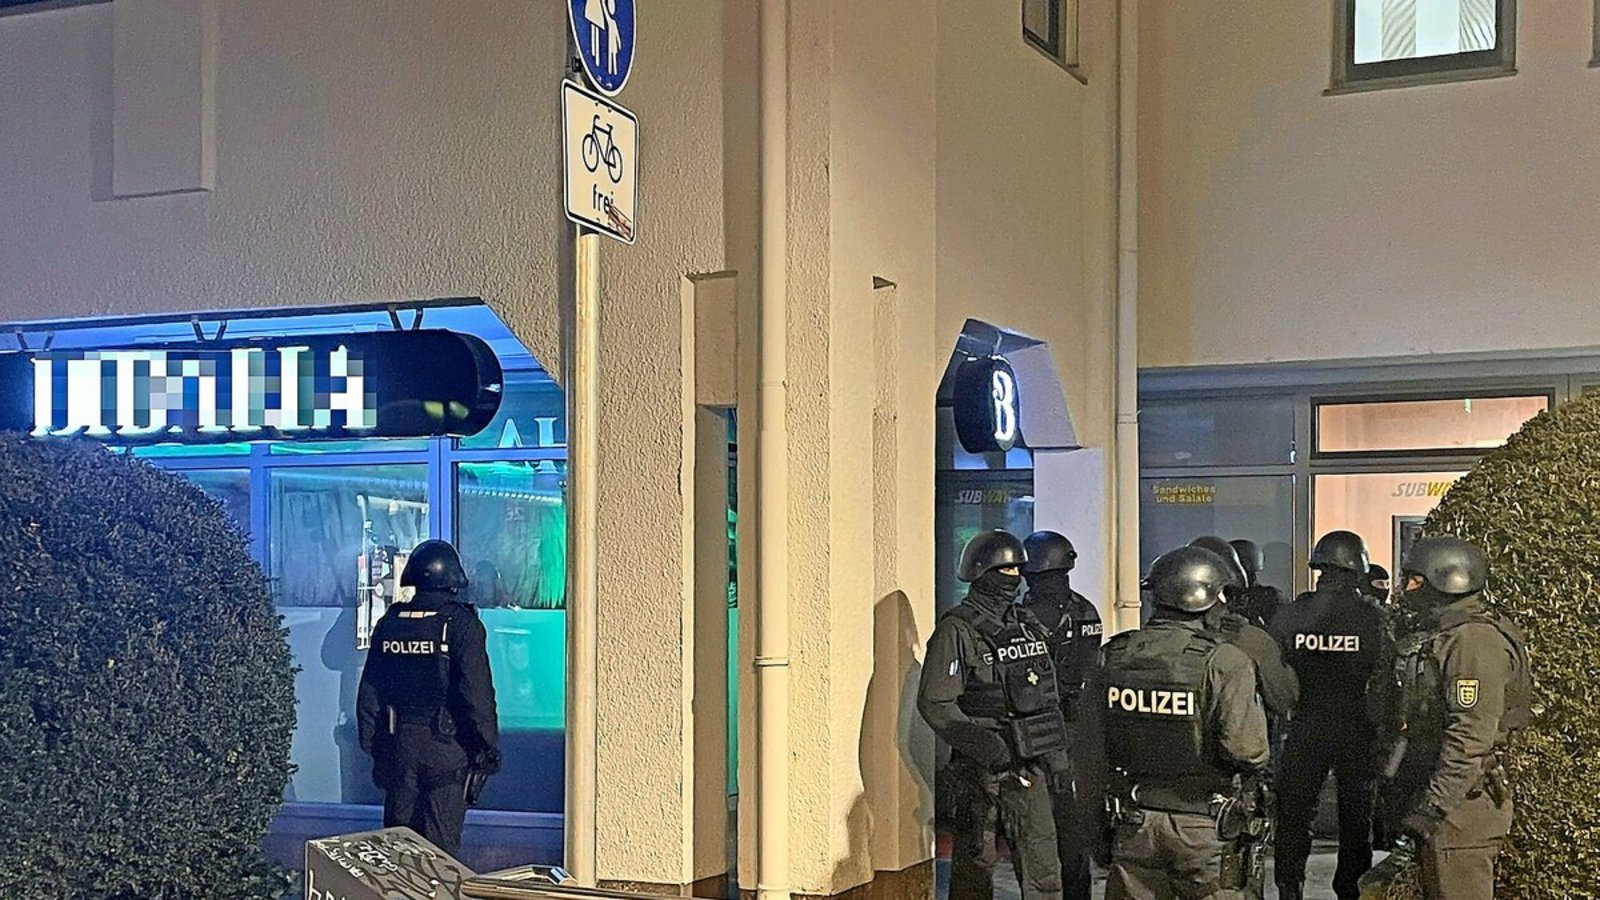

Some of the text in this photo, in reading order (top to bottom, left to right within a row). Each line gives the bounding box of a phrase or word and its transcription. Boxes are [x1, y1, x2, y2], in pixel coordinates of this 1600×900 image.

[1152, 484, 1216, 494] Sandwiches
[1391, 482, 1452, 497] SUBW
[1156, 494, 1212, 503] und Salate
[382, 641, 435, 655] POLIZEI
[1295, 633, 1360, 652] POLIZEI
[997, 641, 1048, 662] POLIZEI
[1107, 686, 1195, 716] POLIZEI
